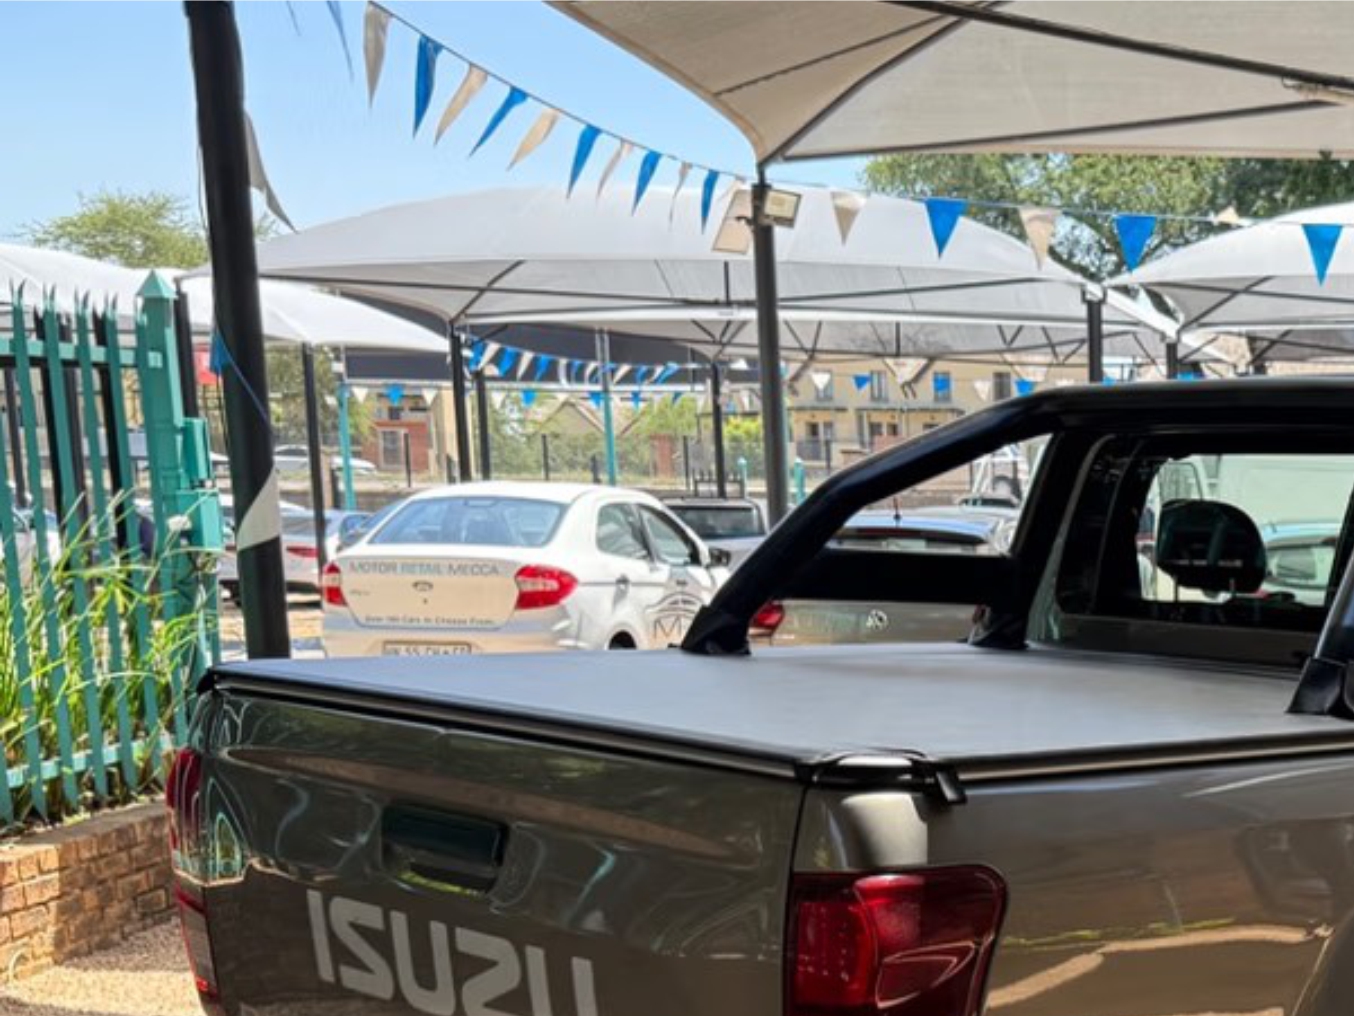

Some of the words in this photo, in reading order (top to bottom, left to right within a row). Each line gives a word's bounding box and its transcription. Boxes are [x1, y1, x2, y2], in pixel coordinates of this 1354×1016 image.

[350, 561, 397, 574] MOTOR
[402, 562, 442, 574] RETAIL
[448, 563, 499, 576] MECCA
